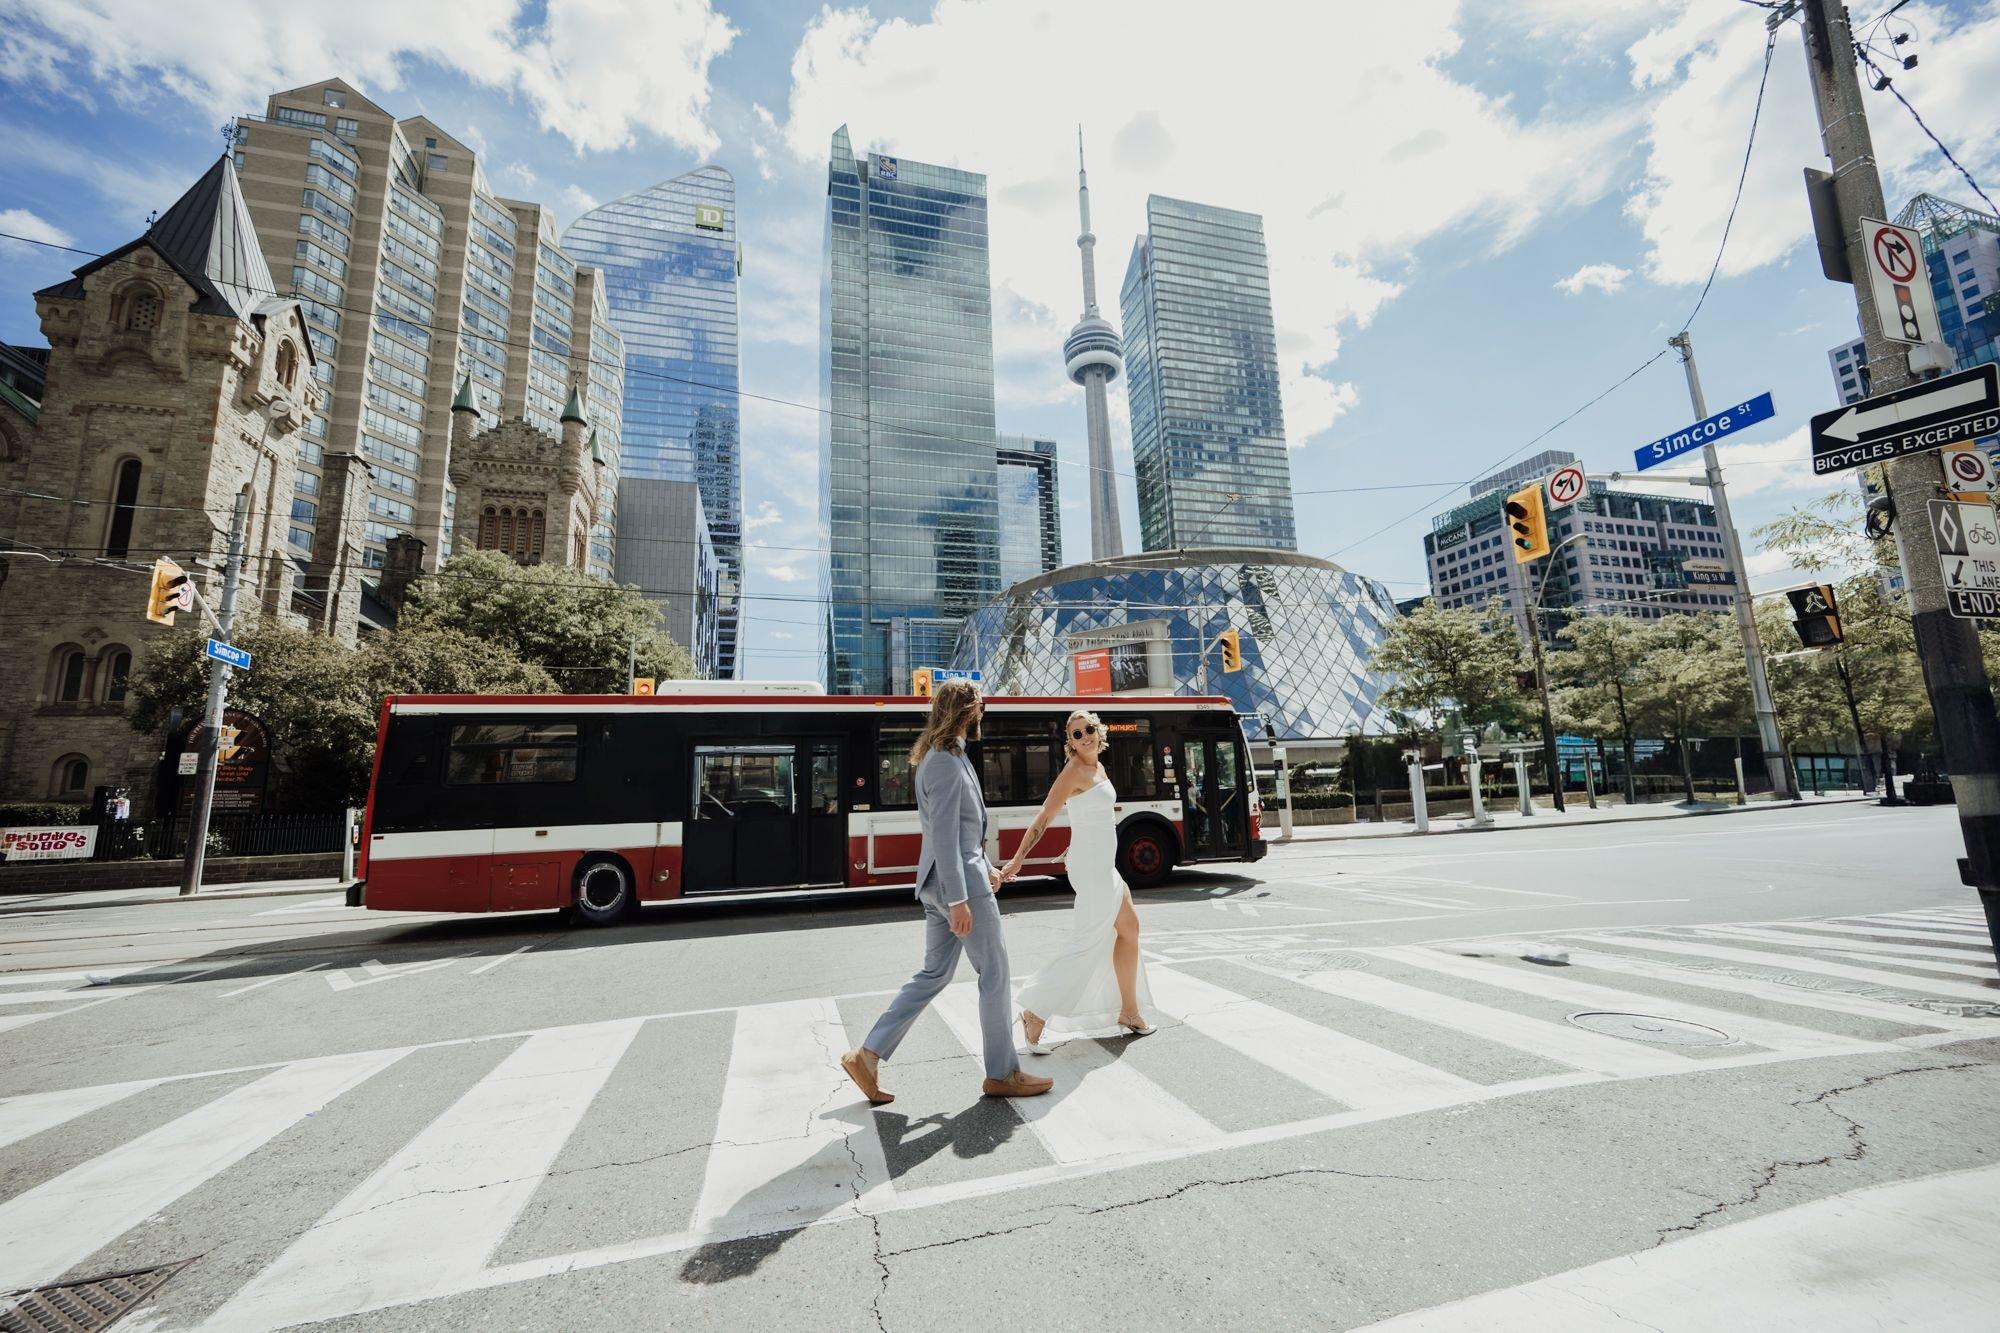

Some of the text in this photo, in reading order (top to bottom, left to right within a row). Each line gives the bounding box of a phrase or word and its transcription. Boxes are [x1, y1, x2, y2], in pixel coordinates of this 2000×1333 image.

[880, 170, 896, 178] RBC
[698, 207, 721, 223] TD
[1652, 403, 1752, 459] Simcoe St
[1815, 415, 2000, 472] BICYCLES EXCEPTED
[1973, 559, 1996, 573] THIS
[1692, 571, 1710, 583] King
[1132, 627, 1154, 638] HALL
[214, 642, 240, 662] Simcoe
[942, 671, 959, 680] King
[1109, 723, 1137, 732] BATHURST
